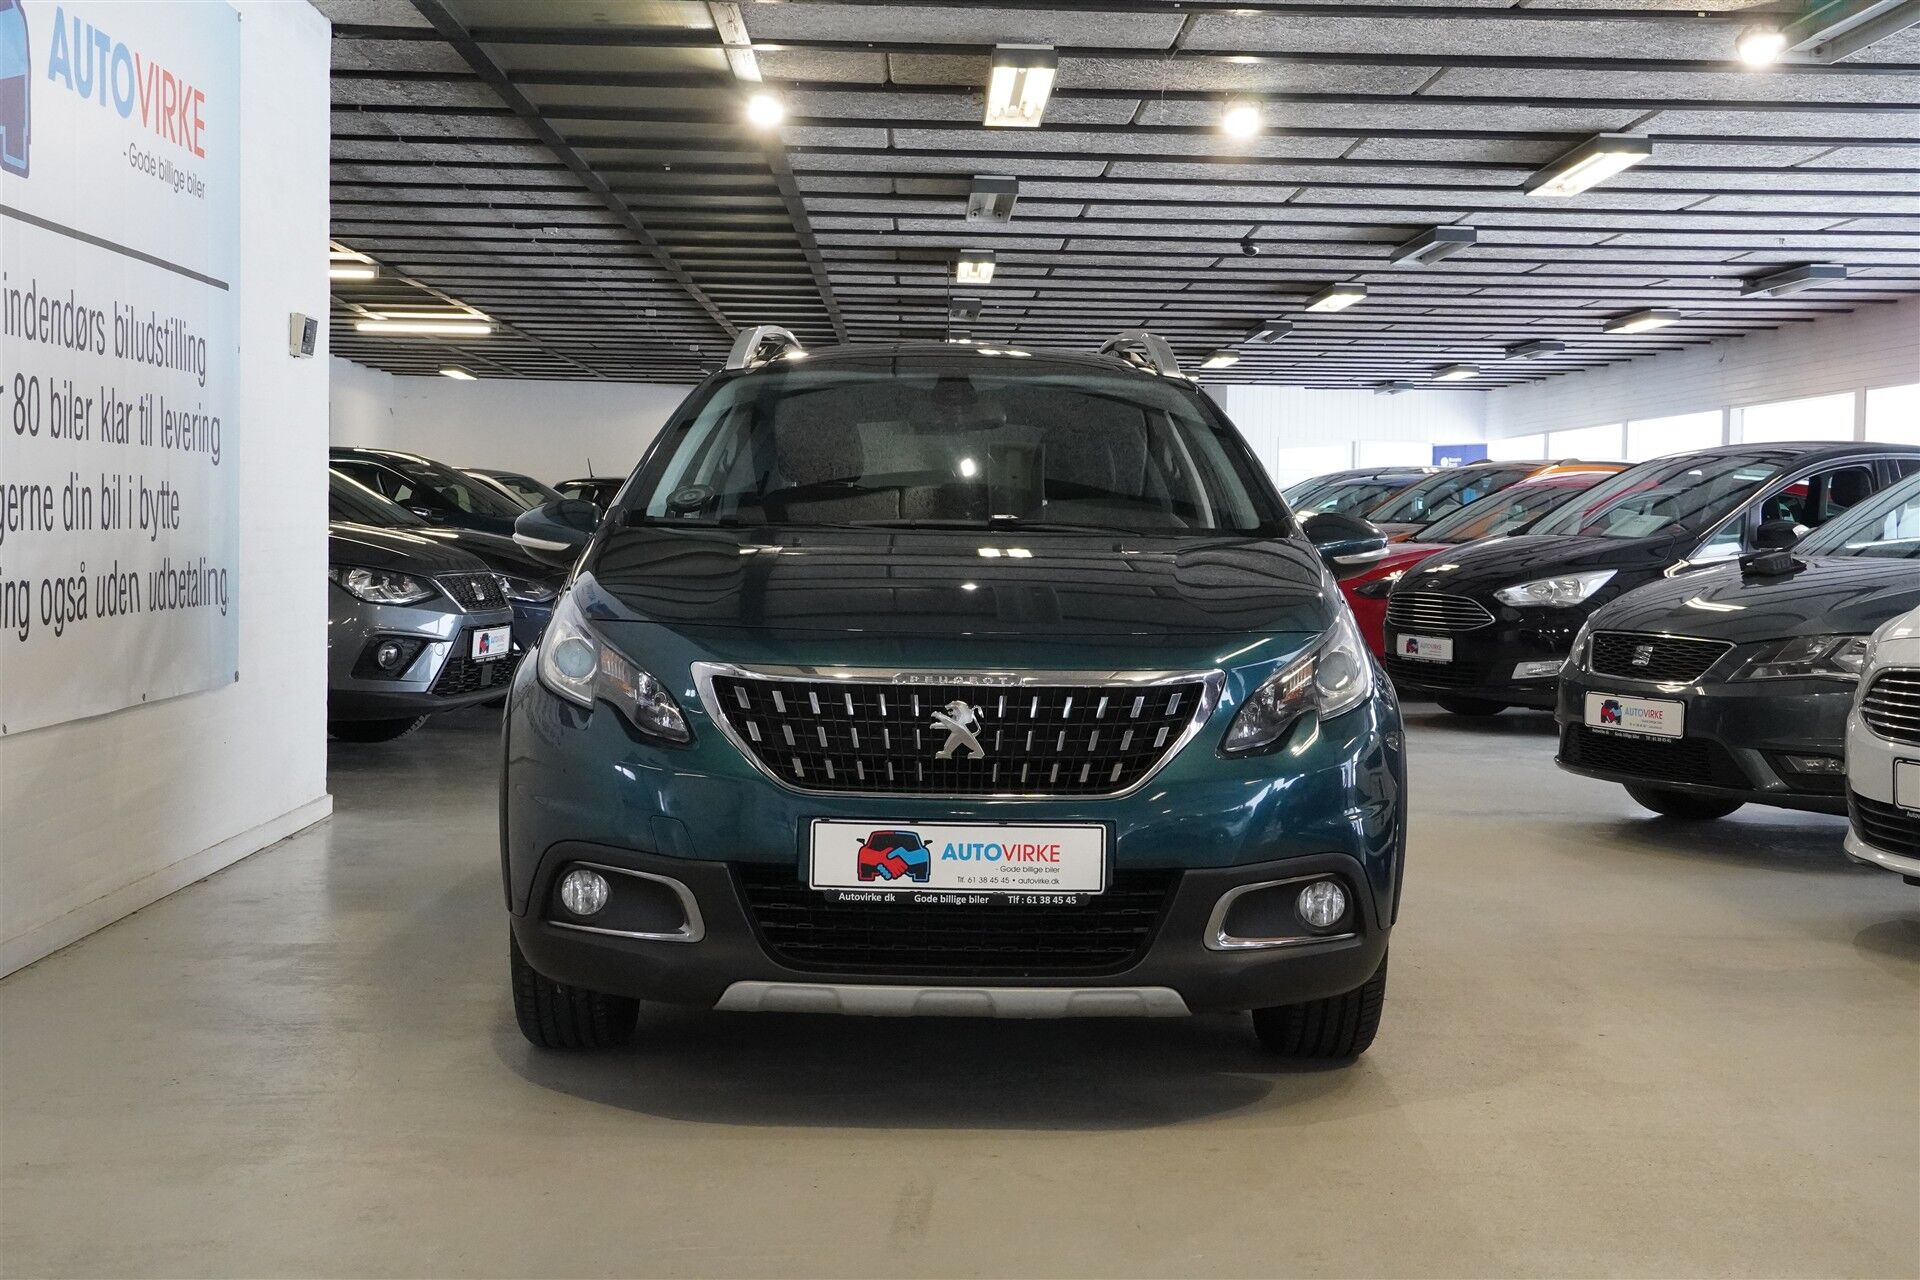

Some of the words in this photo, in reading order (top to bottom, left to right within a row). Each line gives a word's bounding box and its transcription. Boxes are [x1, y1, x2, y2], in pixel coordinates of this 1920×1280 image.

[48, 6, 205, 159] AUTOVIRKE
[129, 142, 157, 177] Gode
[158, 156, 185, 194] billige
[187, 170, 205, 200] biler
[4, 272, 106, 356] indendørs
[114, 301, 206, 387] biludstilling
[13, 372, 40, 437] 80
[50, 377, 93, 440] biler
[101, 386, 133, 445] klar
[139, 392, 153, 446] til
[160, 395, 221, 466] levering
[63, 472, 92, 531] din
[101, 473, 121, 530] bil
[129, 475, 132, 530] i
[140, 475, 180, 542] bytte
[41, 561, 87, 638] også
[96, 560, 141, 618] uden
[909, 674, 1008, 686] PEUGEOT
[1624, 706, 1664, 720] AUTOVIRKE
[941, 842, 1060, 862] AUTOVIRKE
[1000, 865, 1021, 873] Gode
[1022, 866, 1043, 875] billige
[838, 892, 882, 902] Autovirke
[884, 893, 896, 902] dk
[914, 894, 938, 903] Gode
[940, 894, 967, 905] billige
[969, 895, 990, 904] biler
[1008, 895, 1020, 904] Tlf
[1026, 896, 1038, 904] 61
[1040, 896, 1051, 904] 38
[1052, 896, 1064, 904] 45
[967, 876, 976, 884] 61
[978, 876, 988, 884] 38
